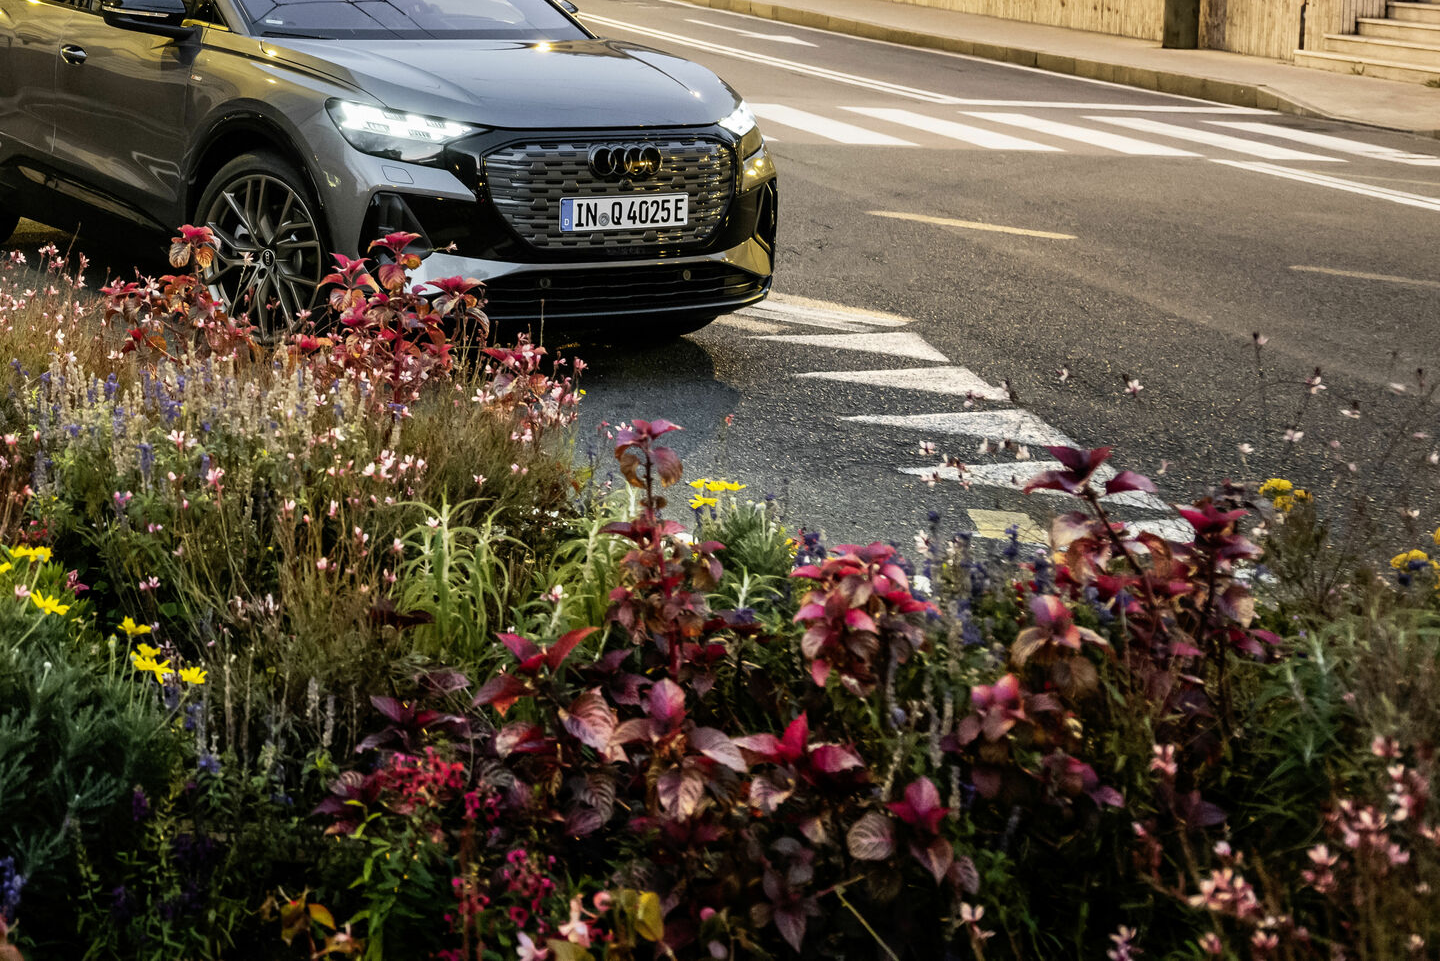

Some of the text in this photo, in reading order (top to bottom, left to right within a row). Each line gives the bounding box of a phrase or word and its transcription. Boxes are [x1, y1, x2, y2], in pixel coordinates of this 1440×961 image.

[563, 218, 570, 226] D
[574, 202, 598, 227] IN
[611, 201, 623, 226] Q
